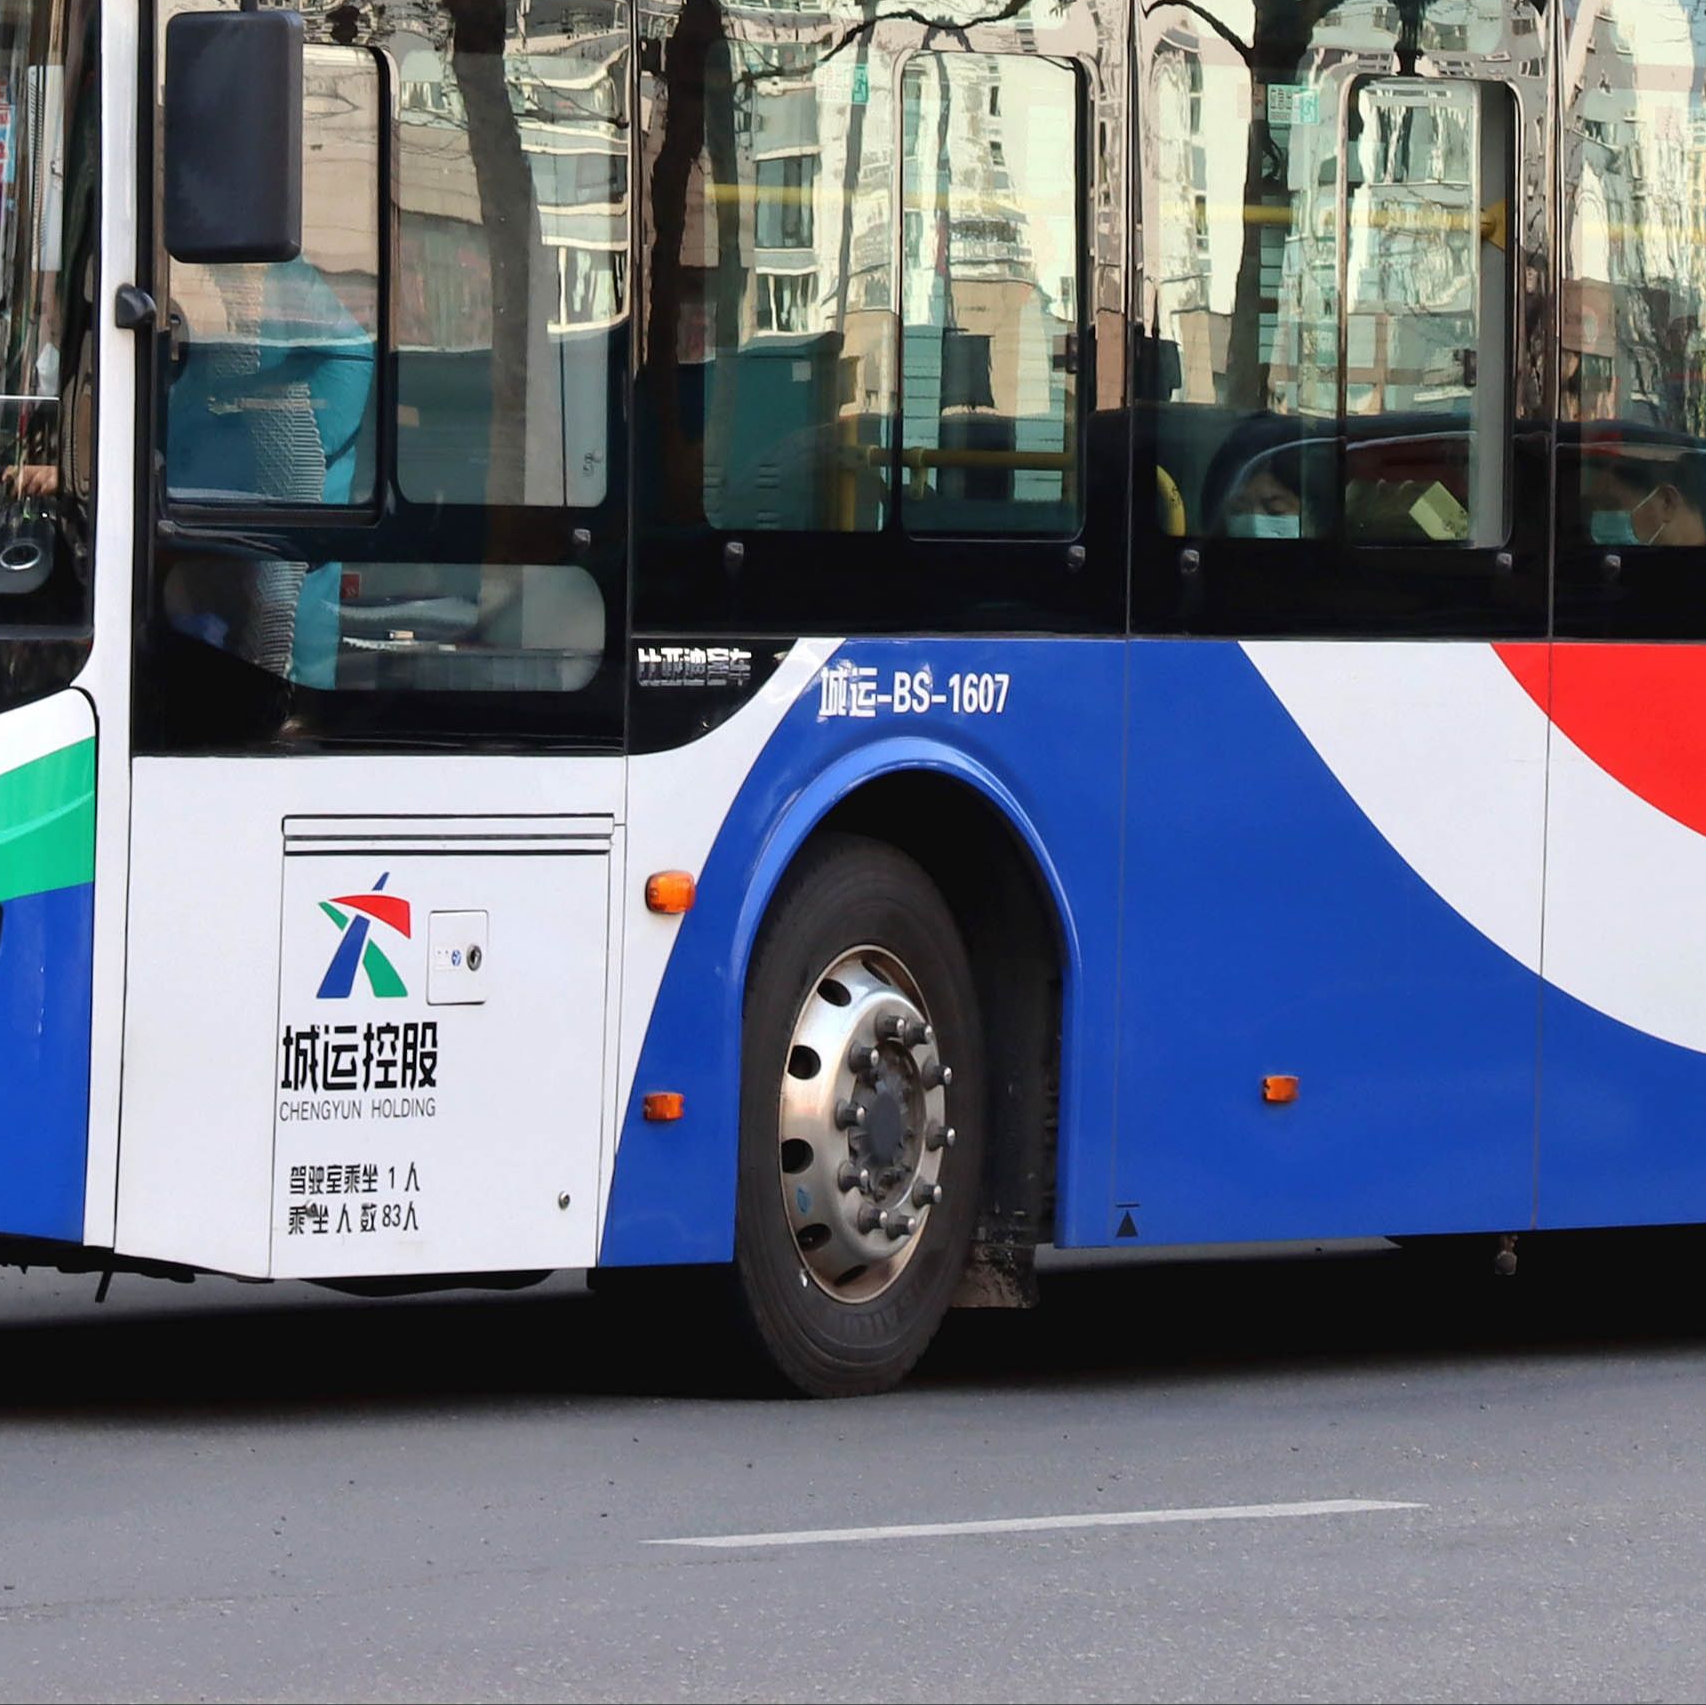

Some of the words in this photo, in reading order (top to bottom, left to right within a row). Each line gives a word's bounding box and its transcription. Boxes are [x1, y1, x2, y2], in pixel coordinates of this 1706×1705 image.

[280, 1020, 439, 1094] 城运控股
[278, 1099, 363, 1123] CHENGYUN
[370, 1096, 437, 1120] HOLDING
